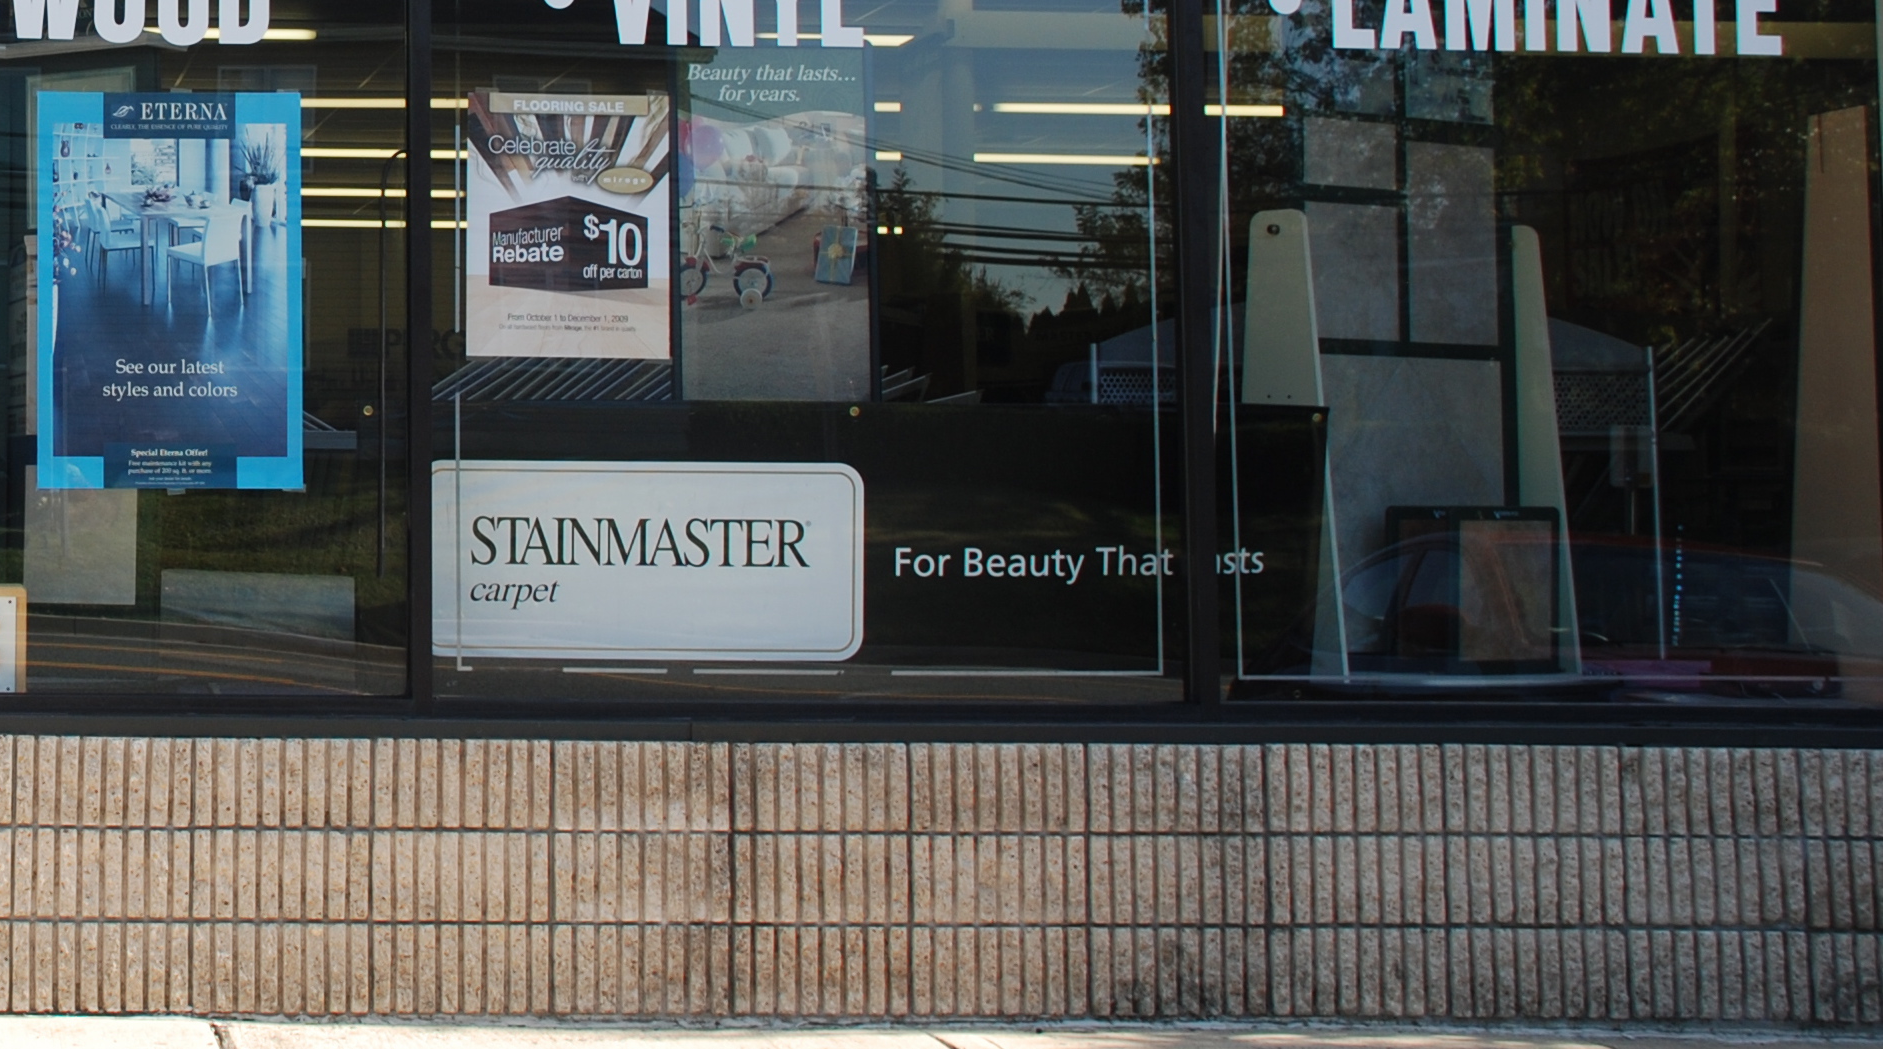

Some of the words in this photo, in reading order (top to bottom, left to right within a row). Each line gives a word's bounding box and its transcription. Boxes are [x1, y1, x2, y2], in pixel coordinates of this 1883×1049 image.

[687, 64, 751, 85] Beauty
[756, 65, 794, 82] that
[717, 85, 746, 102] for
[748, 88, 801, 105] years.
[140, 102, 228, 121] ETERNA
[513, 100, 584, 112] FLOORING
[588, 102, 625, 113] SALE
[488, 134, 576, 155] Celebrate
[532, 138, 616, 186] quality
[492, 226, 564, 247] Manufacturer
[583, 213, 643, 267] $10
[493, 243, 564, 263] Rebate
[583, 264, 598, 279] off
[599, 267, 615, 281] per
[617, 266, 642, 279] carton
[526, 313, 552, 322] October
[560, 313, 566, 322] to
[568, 313, 602, 323] December
[115, 358, 144, 374] See
[147, 362, 177, 374] our
[181, 358, 225, 374] latest
[102, 381, 149, 401] styles
[153, 381, 184, 397] and
[188, 381, 238, 397] colors
[131, 448, 158, 458] Special
[471, 515, 810, 567] STAINMASTER
[894, 547, 951, 577] For
[964, 548, 1084, 585] Beauty
[1096, 545, 1173, 576] That
[469, 580, 560, 610] carpet
